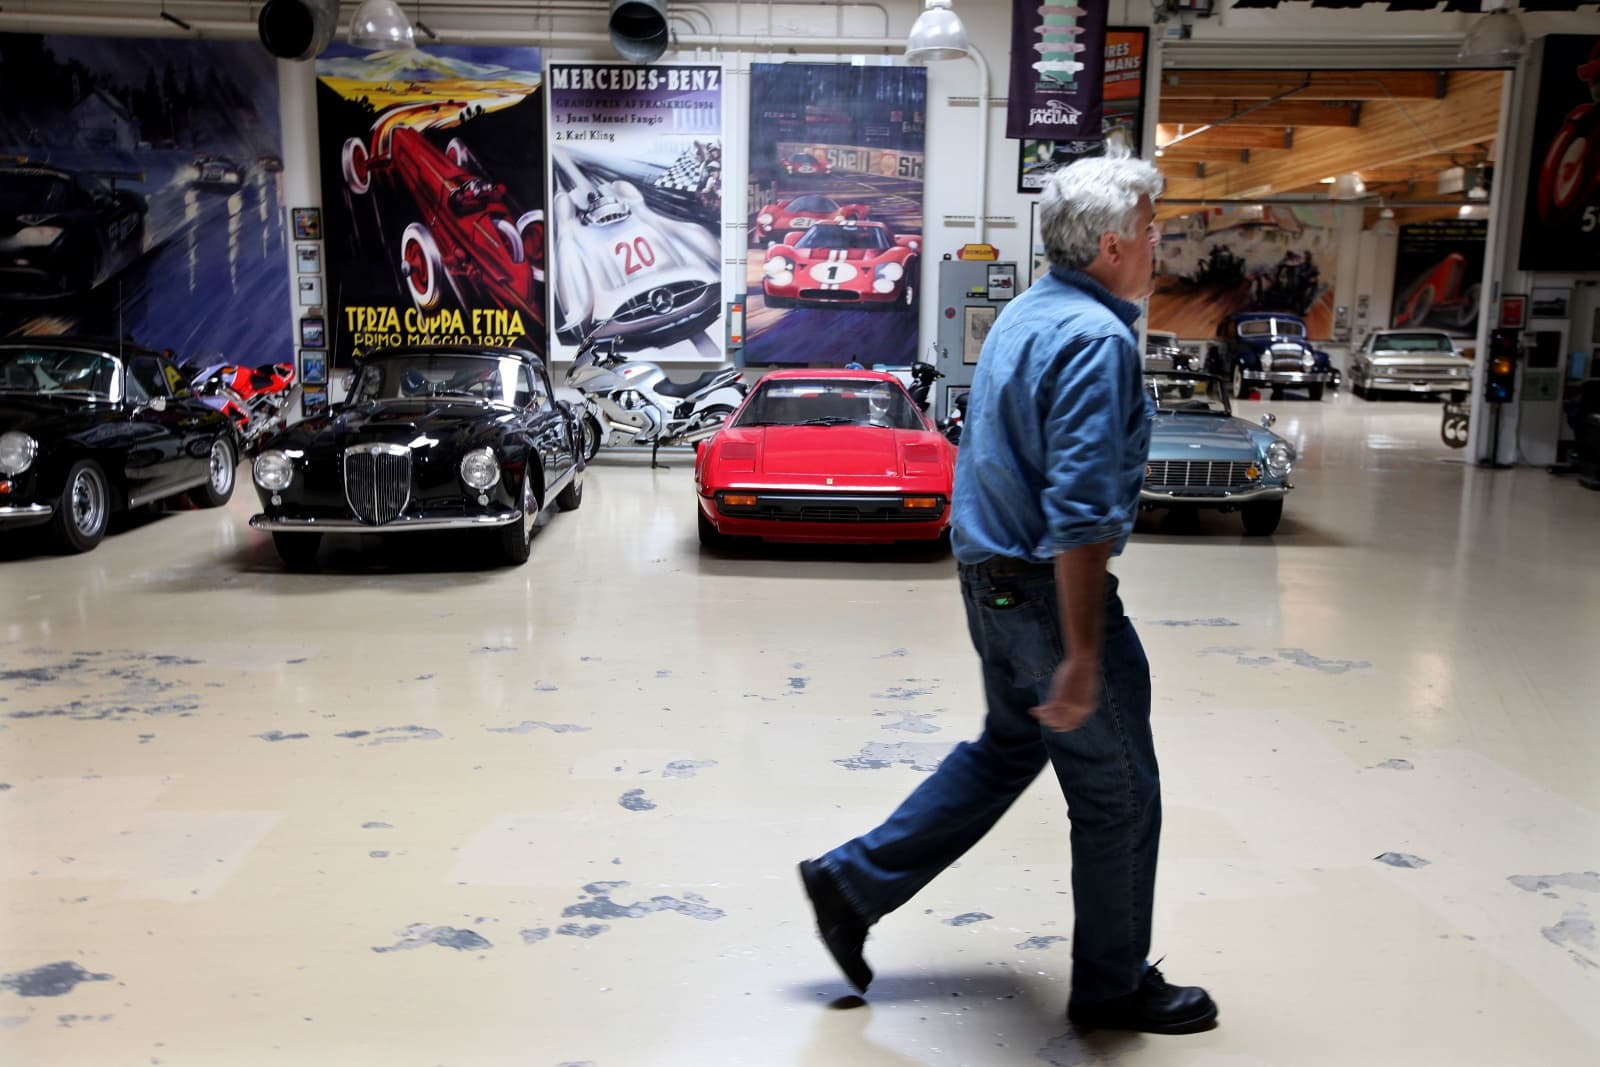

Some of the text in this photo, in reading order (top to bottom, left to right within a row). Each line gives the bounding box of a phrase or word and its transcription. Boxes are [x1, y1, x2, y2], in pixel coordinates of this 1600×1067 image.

[552, 68, 719, 91] MERCEDES-BENZ
[566, 113, 590, 124] Juan
[592, 113, 628, 123] Manuel
[631, 113, 663, 126] Fangio
[1028, 111, 1078, 126] JAGUAR
[566, 130, 586, 140] Karl
[590, 130, 615, 142] Kling
[827, 150, 868, 172] Shell
[1581, 206, 1600, 232] 5
[615, 236, 655, 275] 20
[827, 266, 838, 279] 1
[345, 306, 401, 332] TERZA
[472, 309, 526, 336] ETNA
[354, 333, 402, 347] PRIMO
[1444, 419, 1468, 442] 66
